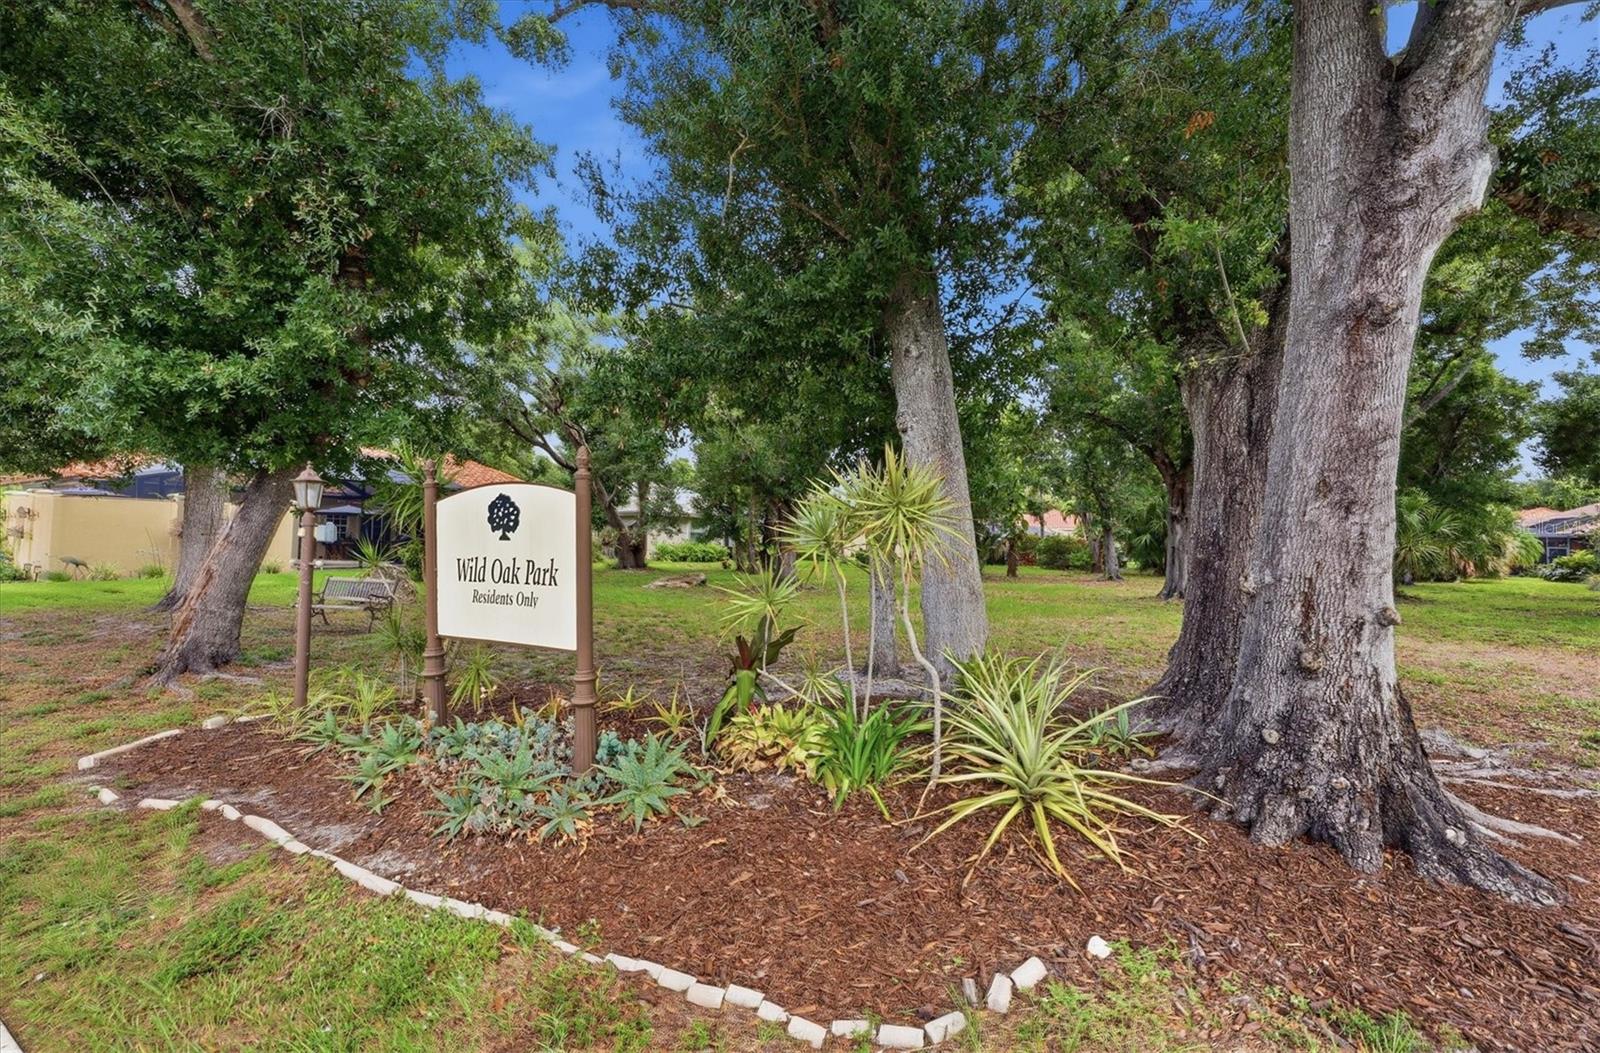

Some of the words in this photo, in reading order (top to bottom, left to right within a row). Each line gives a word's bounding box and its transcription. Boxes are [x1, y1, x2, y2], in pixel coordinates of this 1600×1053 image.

[456, 556, 487, 583] Wild
[491, 557, 520, 585] Oak
[524, 558, 559, 587] Park
[472, 589, 513, 606] Residents
[516, 591, 539, 609] Only
